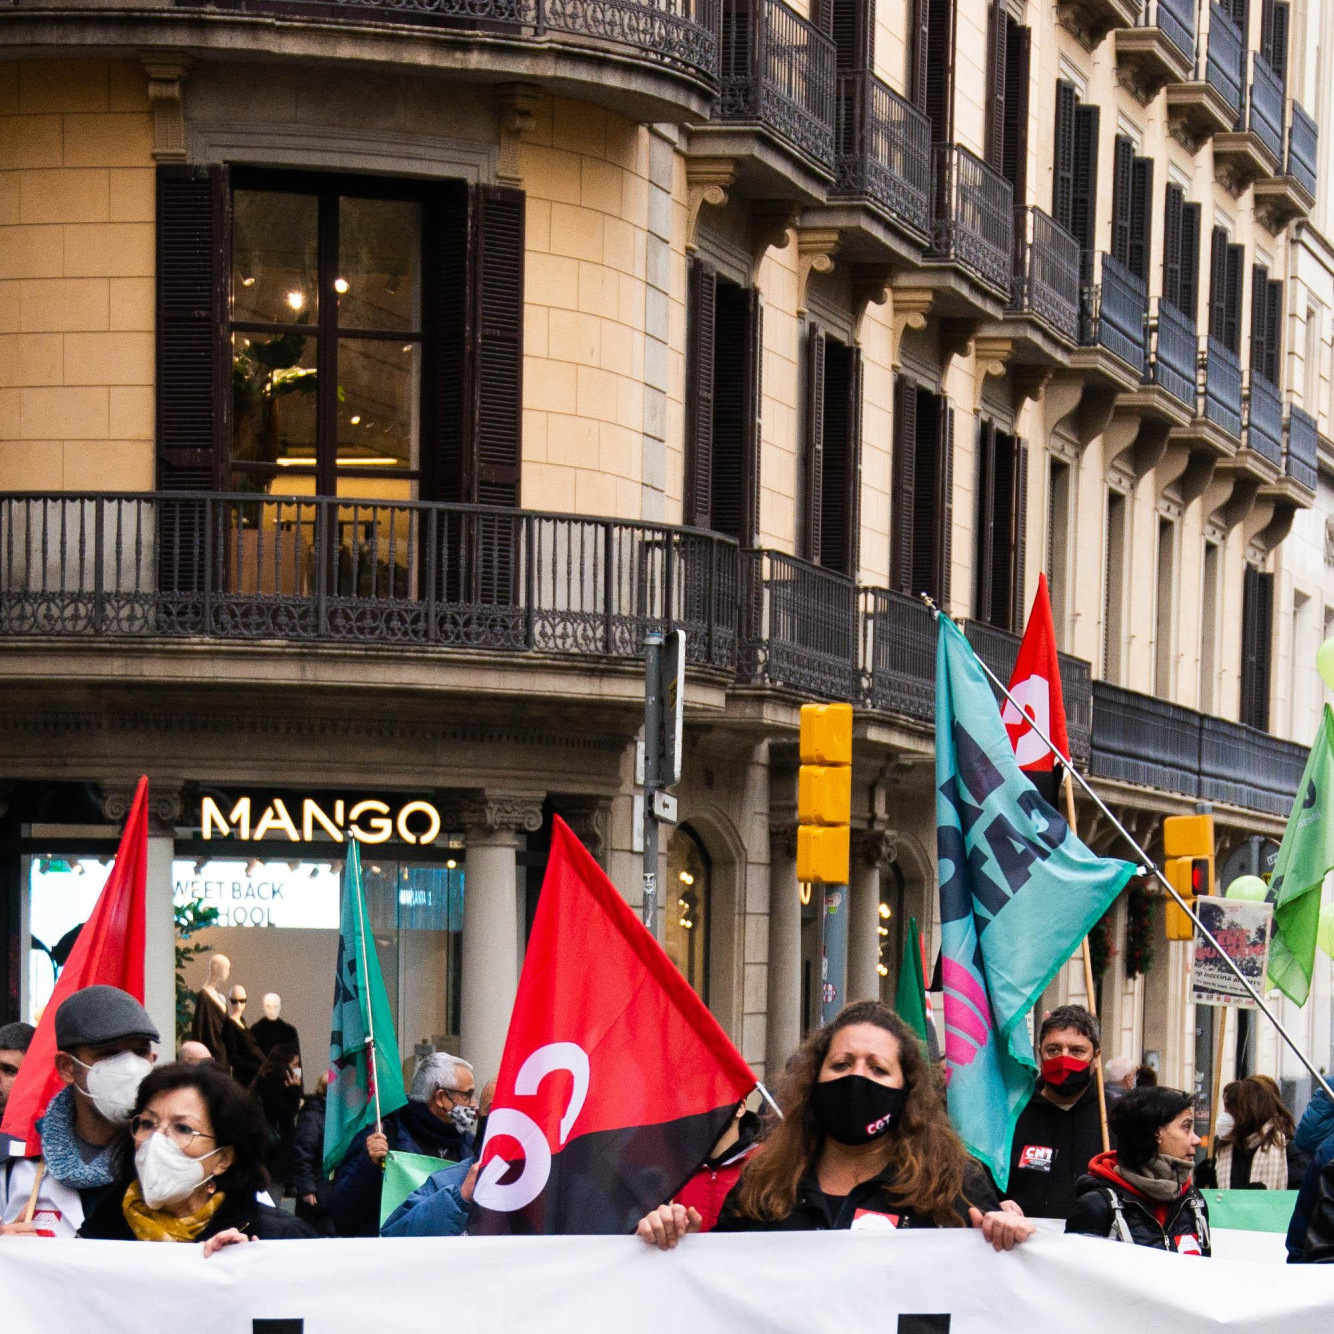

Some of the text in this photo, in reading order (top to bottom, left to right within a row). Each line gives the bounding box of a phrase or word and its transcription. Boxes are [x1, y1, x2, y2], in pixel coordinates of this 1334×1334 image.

[200, 796, 442, 846] MANGO
[172, 880, 285, 901] WEET BACK
[867, 1113, 892, 1135] CGT
[1026, 1146, 1053, 1160] CNT
